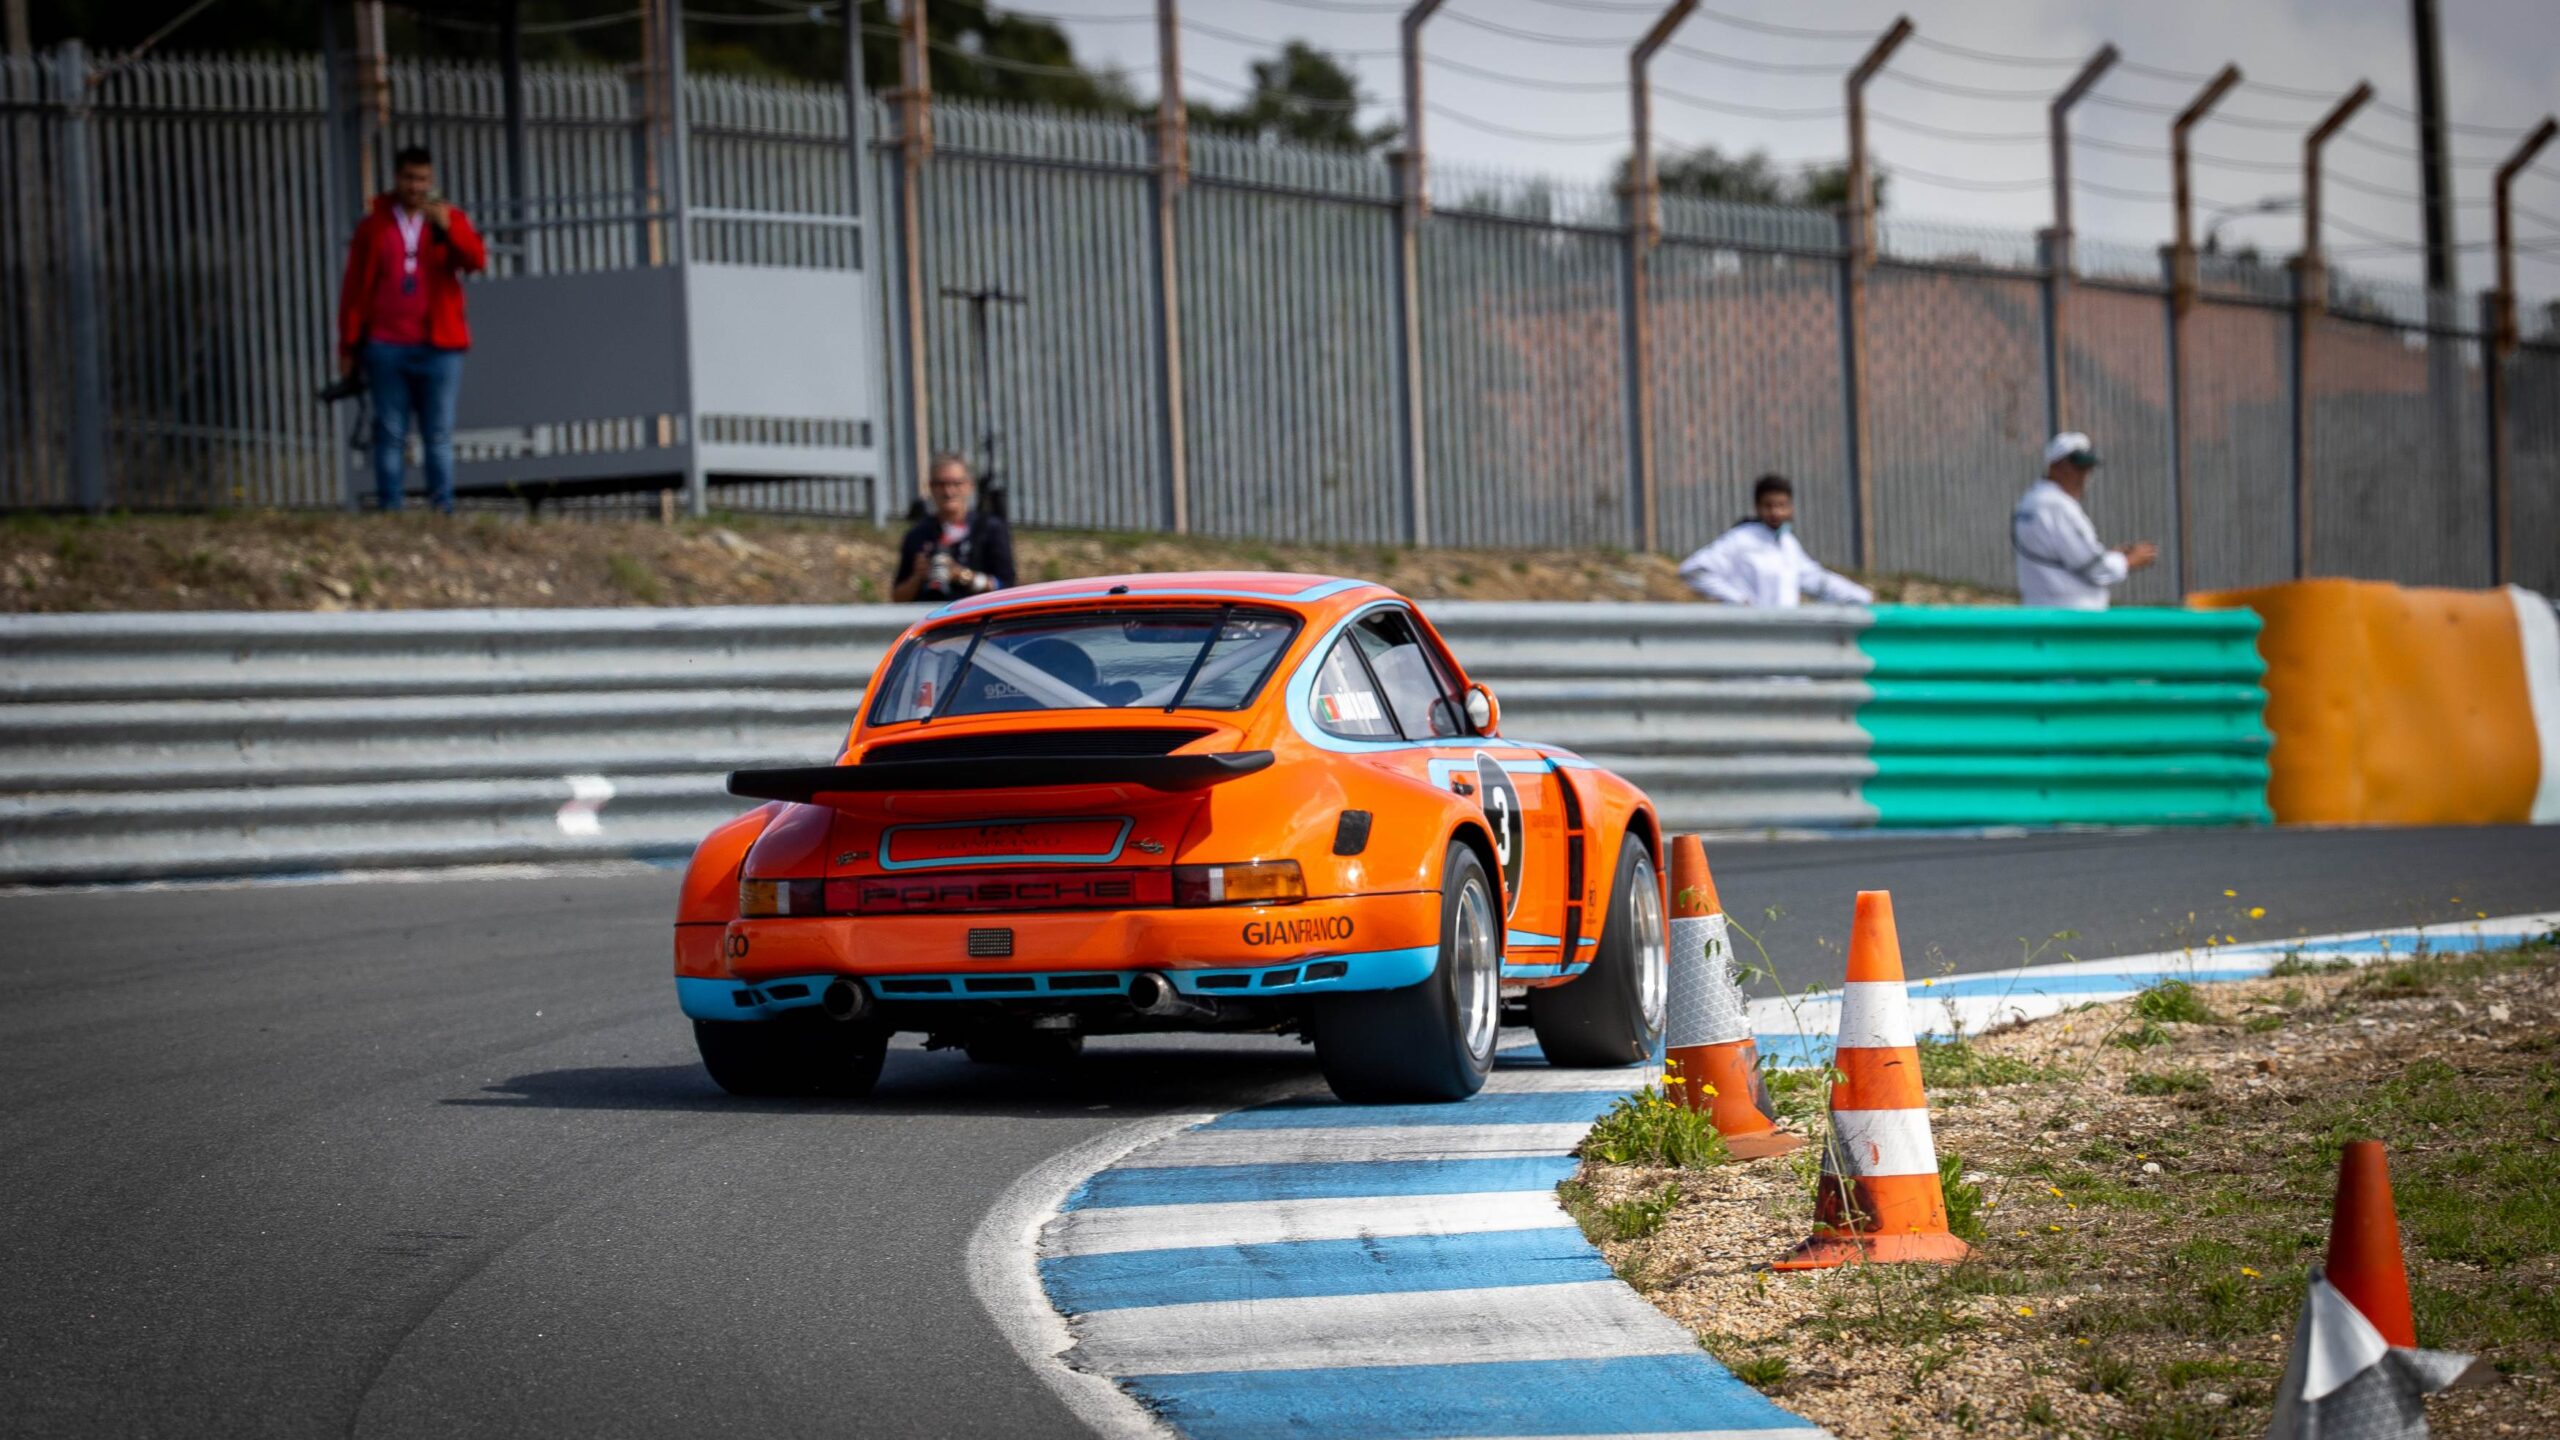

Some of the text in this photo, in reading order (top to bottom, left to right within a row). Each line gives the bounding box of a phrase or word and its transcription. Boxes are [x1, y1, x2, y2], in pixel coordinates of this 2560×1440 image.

[1492, 786, 1511, 866] 3
[862, 880, 1131, 905] PORSCHE
[1242, 915, 1355, 946] GIANFRANCO
